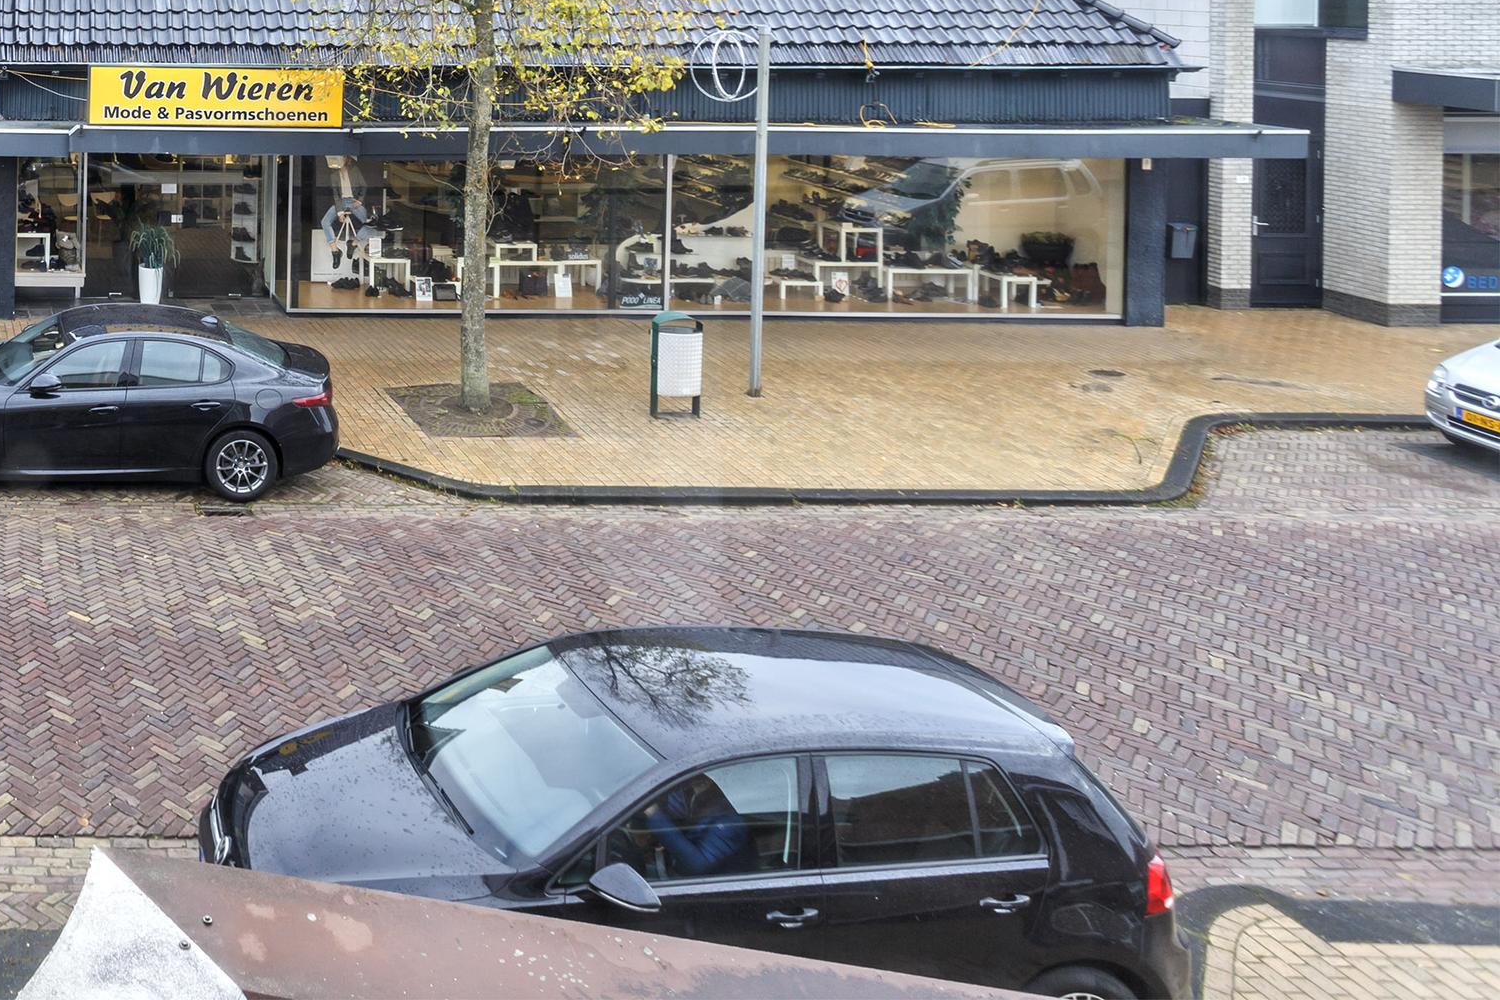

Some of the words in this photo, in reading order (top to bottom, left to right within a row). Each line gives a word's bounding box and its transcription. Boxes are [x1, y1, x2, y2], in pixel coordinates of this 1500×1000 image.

[120, 70, 187, 101] Van
[201, 71, 315, 102] Wieren
[103, 105, 152, 119] Mode
[157, 107, 169, 120] &
[175, 107, 328, 122] Pasvormschoenen
